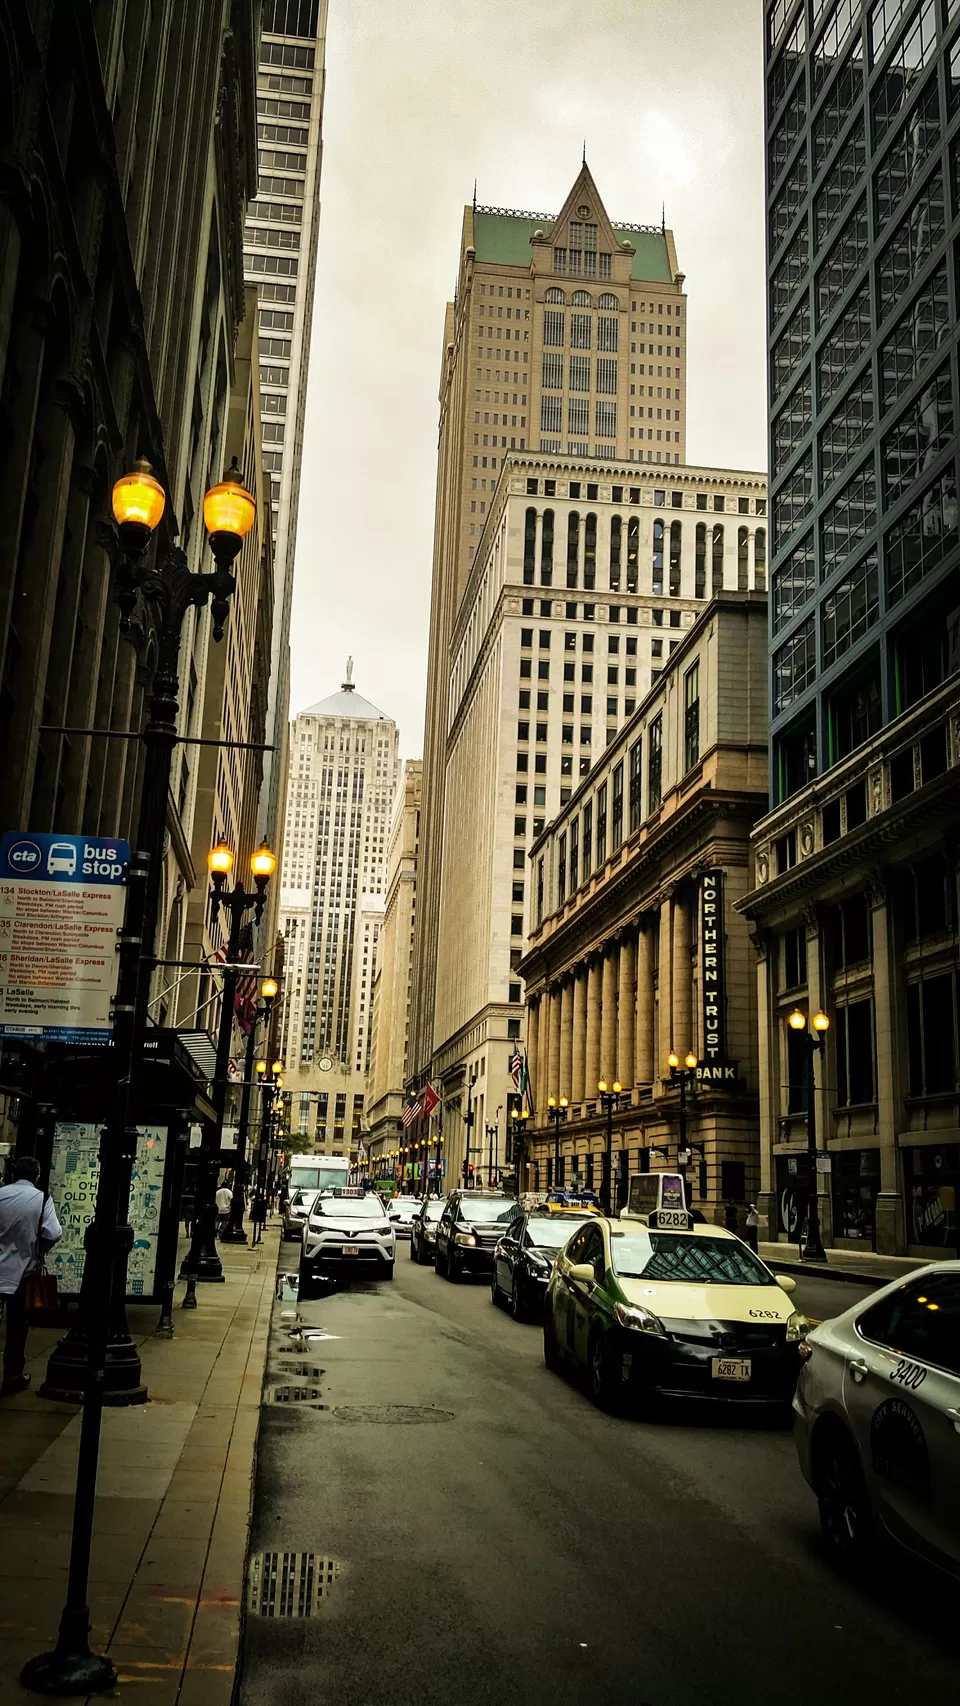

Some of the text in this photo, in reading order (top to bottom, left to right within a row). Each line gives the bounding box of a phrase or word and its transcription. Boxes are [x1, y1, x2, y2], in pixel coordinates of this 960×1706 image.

[13, 850, 36, 862] cta
[84, 844, 116, 860] bus
[82, 860, 122, 880] stop
[0, 886, 112, 901] 134 Stockton/LaSalle Express
[14, 921, 82, 930] Clarendon/LaSalle
[84, 925, 113, 933] Express
[10, 954, 73, 964] Sheridan/LaSalle
[76, 958, 105, 966] Express
[704, 877, 719, 1058] NORTHERN TRUST
[7, 988, 34, 996] LaSalle
[696, 1067, 735, 1079] BANK
[79, 1182, 97, 1190] O'H
[64, 1192, 86, 1201] OLD
[70, 1215, 80, 1223] IN
[658, 1212, 686, 1225] 6282
[749, 1310, 782, 1319] 6282
[718, 1364, 749, 1376] 6282 TX
[890, 1360, 927, 1389] 3400
